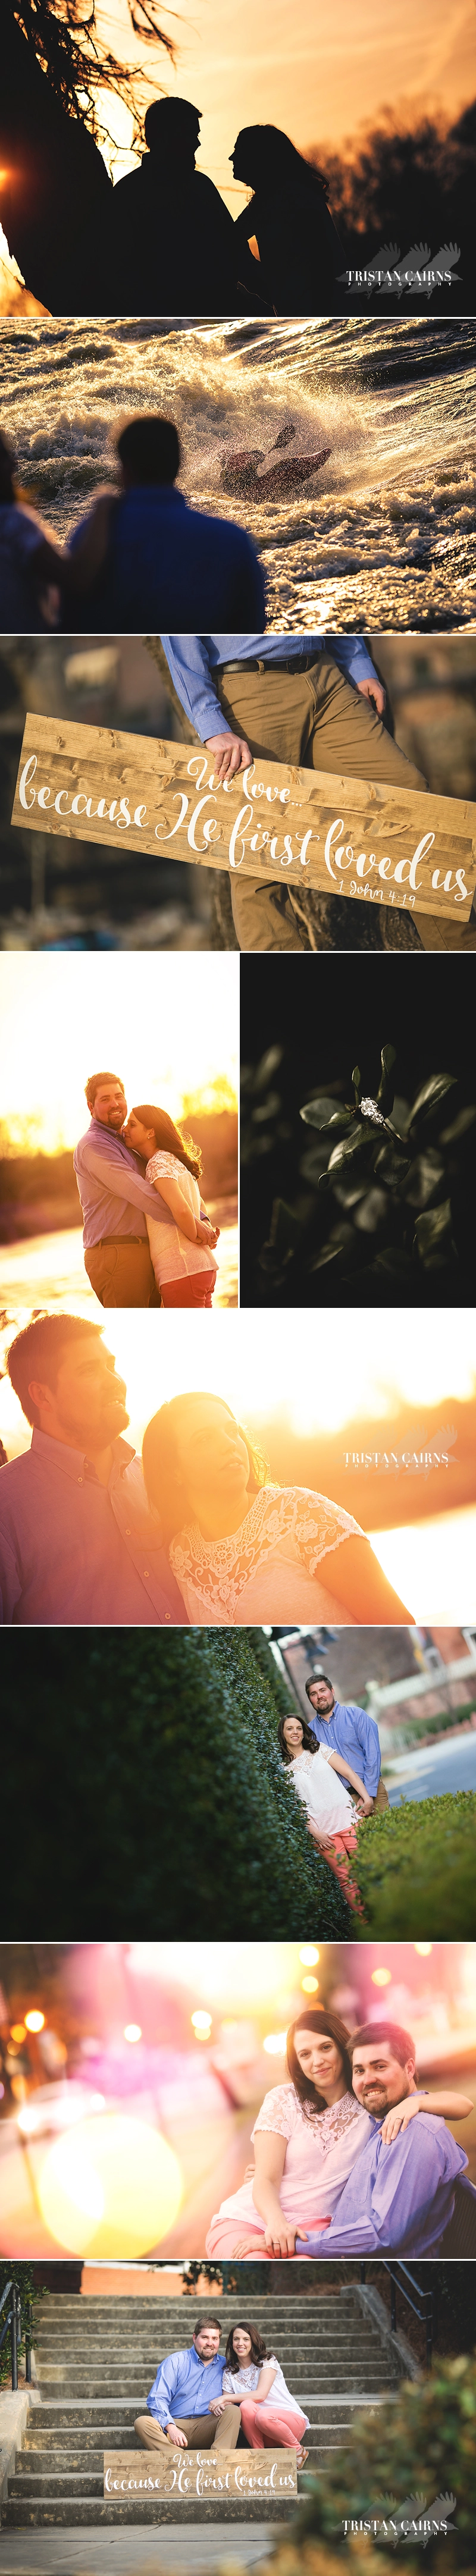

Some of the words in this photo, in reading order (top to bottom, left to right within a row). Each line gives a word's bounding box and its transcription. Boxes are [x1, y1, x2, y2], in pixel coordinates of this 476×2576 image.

[187, 756, 234, 792] We
[19, 755, 149, 829] because
[155, 792, 221, 852] He
[229, 804, 320, 868] first
[324, 818, 435, 890] loved
[432, 868, 473, 902] us
[336, 880, 345, 893] 1
[349, 880, 384, 900] John
[388, 890, 416, 908] 4:19
[173, 2453, 195, 2468] We
[105, 2468, 162, 2492] because
[164, 2468, 192, 2493] He
[196, 2468, 234, 2496] first
[234, 2463, 277, 2492] loved
[279, 2474, 297, 2489] us
